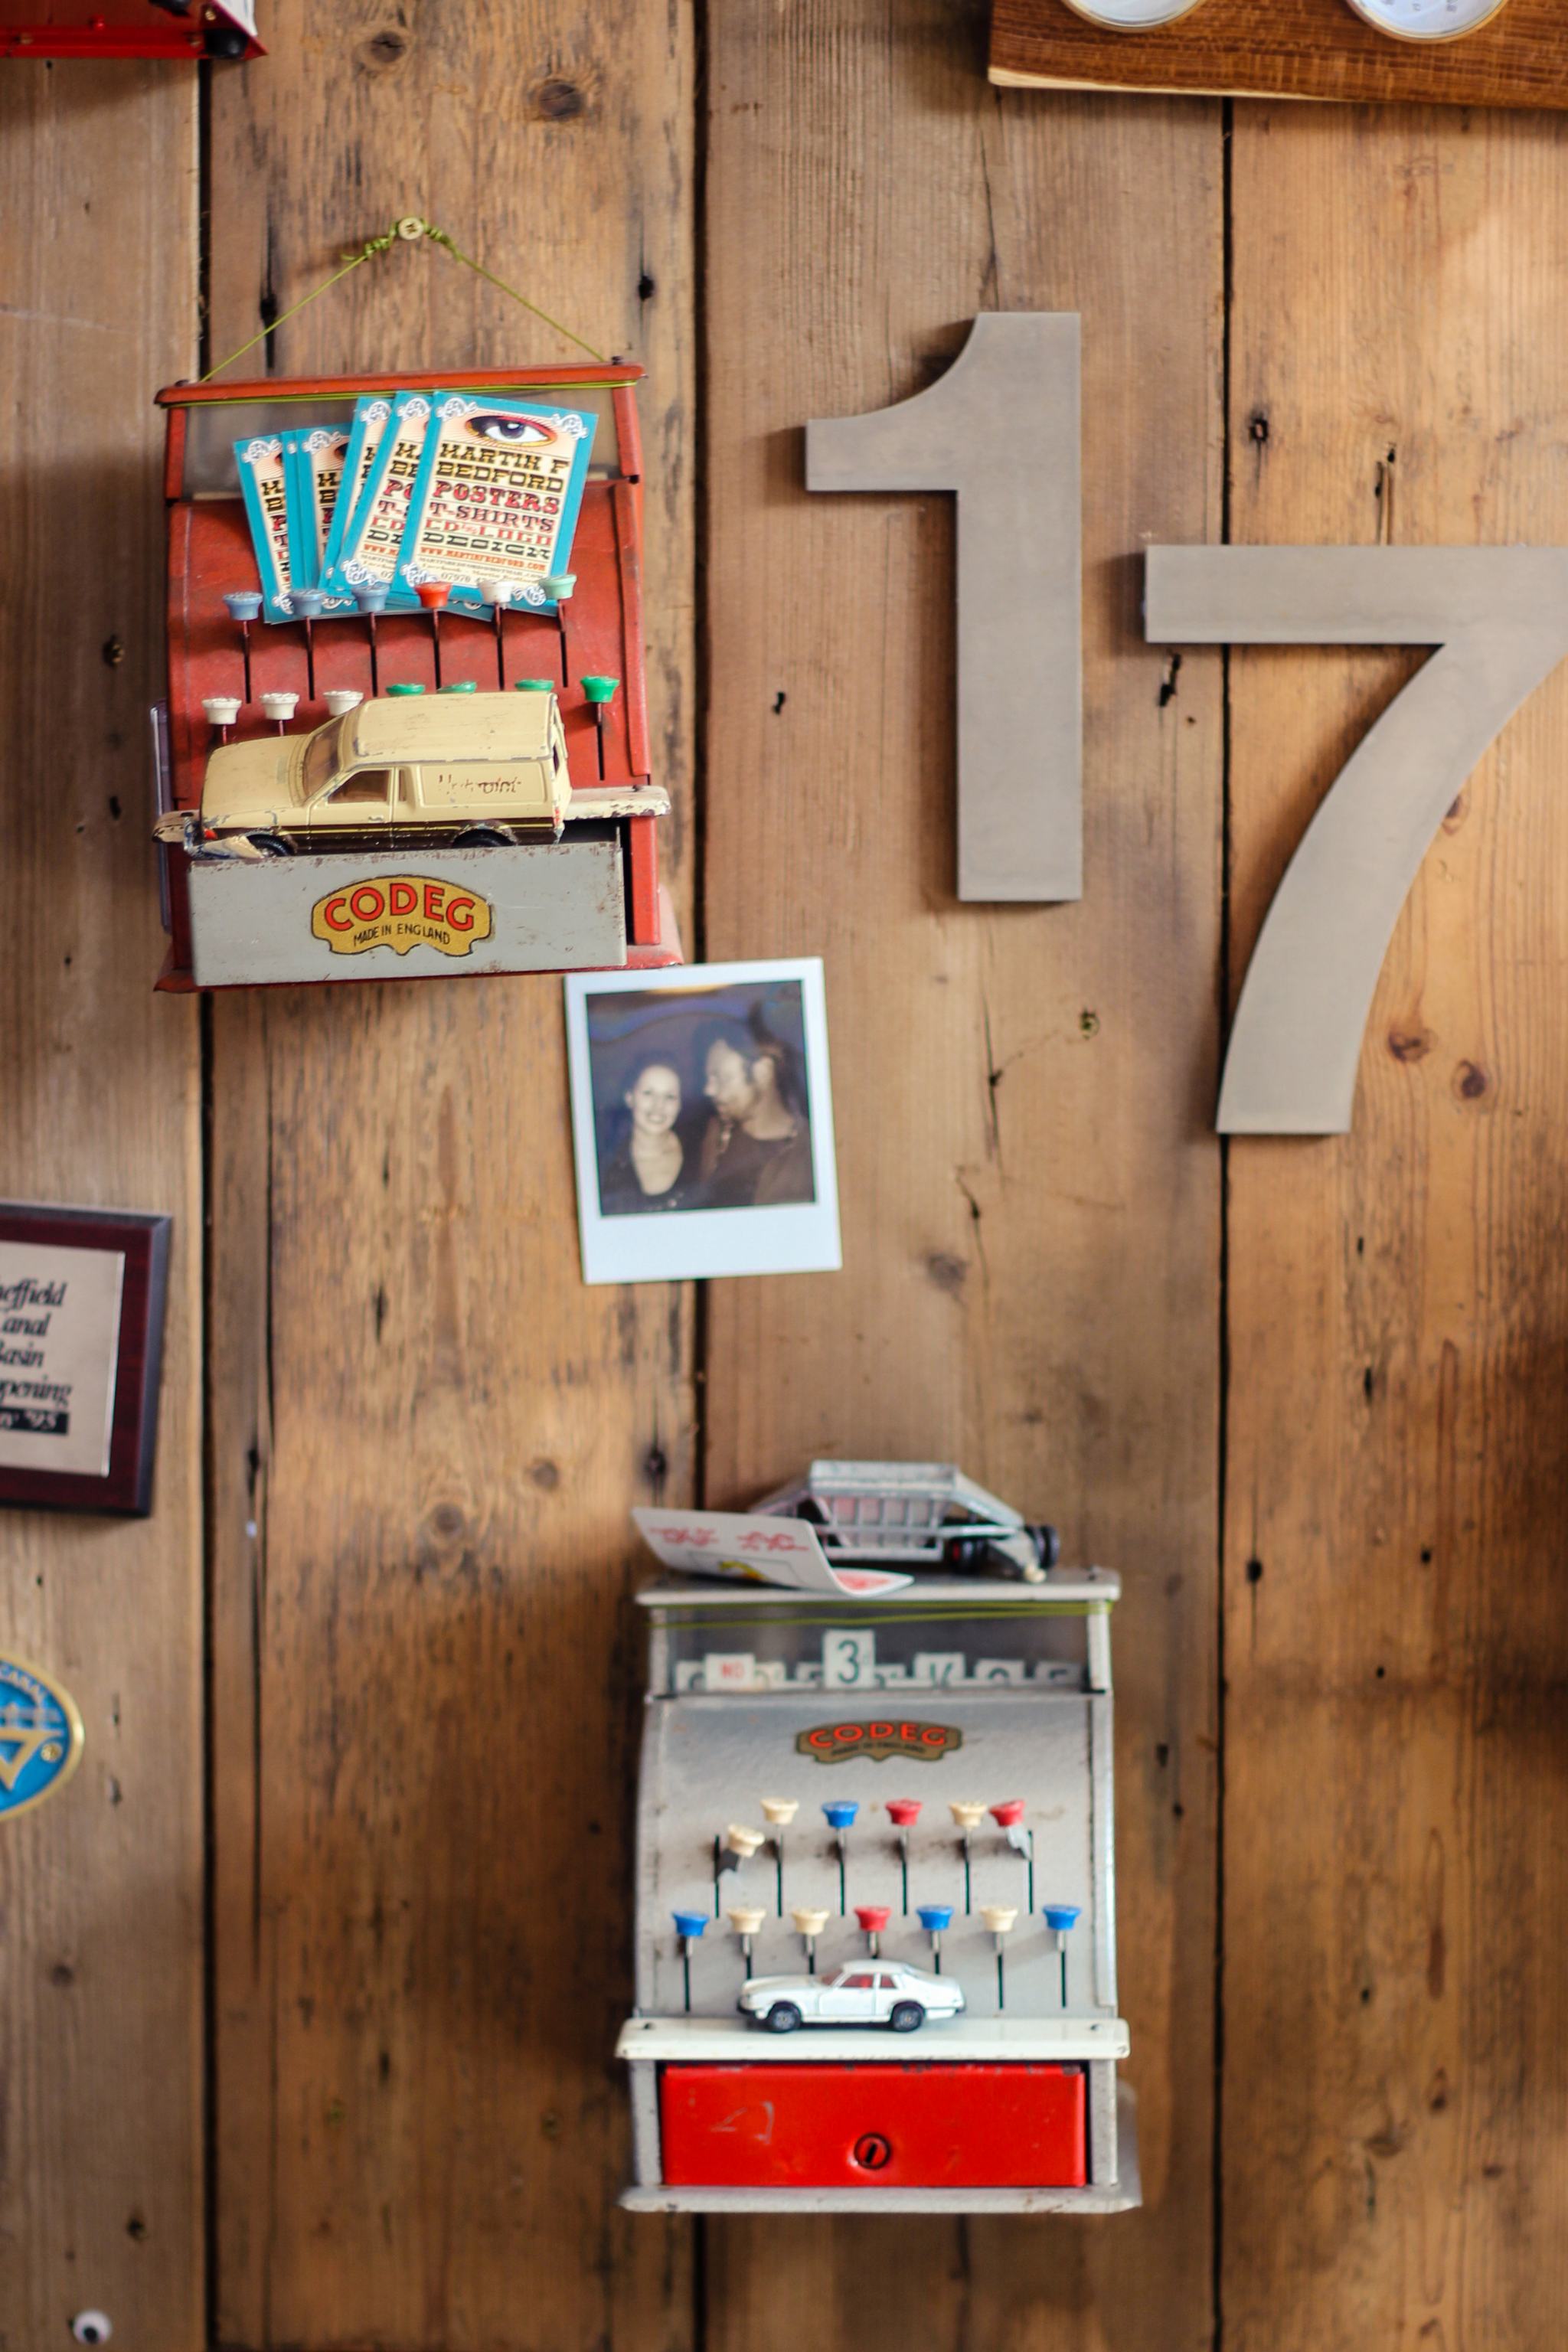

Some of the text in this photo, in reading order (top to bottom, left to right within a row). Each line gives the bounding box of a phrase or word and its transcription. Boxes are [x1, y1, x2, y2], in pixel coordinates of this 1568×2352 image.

[436, 461, 564, 493] BEDFORD
[550, 459, 570, 474] F
[432, 479, 560, 514] POSTERS
[428, 501, 555, 533] T-SHIRTS
[423, 531, 551, 560] DESIGN
[324, 883, 475, 932] CODEG
[354, 923, 451, 946] MADE IN ENGLAND
[808, 1721, 947, 1749] CODEG
